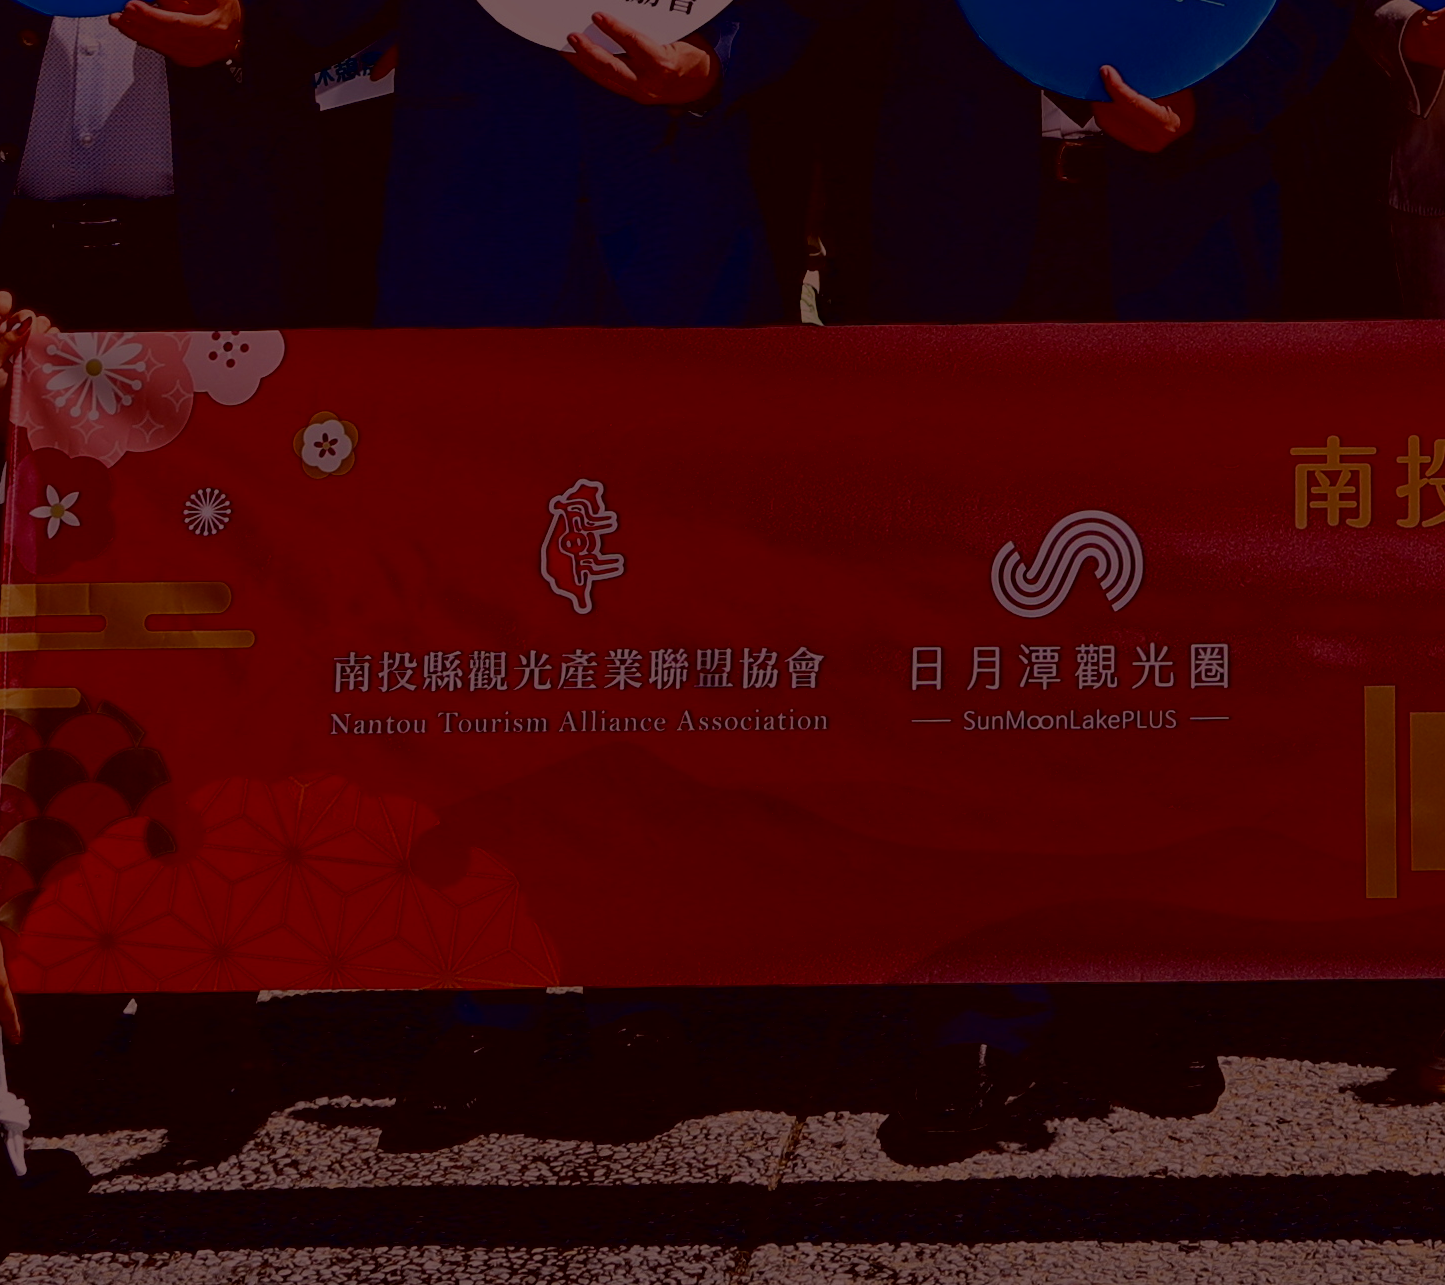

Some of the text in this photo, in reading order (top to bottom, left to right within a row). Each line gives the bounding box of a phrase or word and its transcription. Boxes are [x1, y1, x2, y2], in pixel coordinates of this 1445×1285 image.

[332, 646, 827, 694] 南投縣觀光產業聯盟協會
[909, 642, 1232, 693] 日月潭觀光圈
[329, 707, 829, 737] Nantou Tourism Alliance Association
[962, 707, 1179, 733] SunMoonLakePLUS
